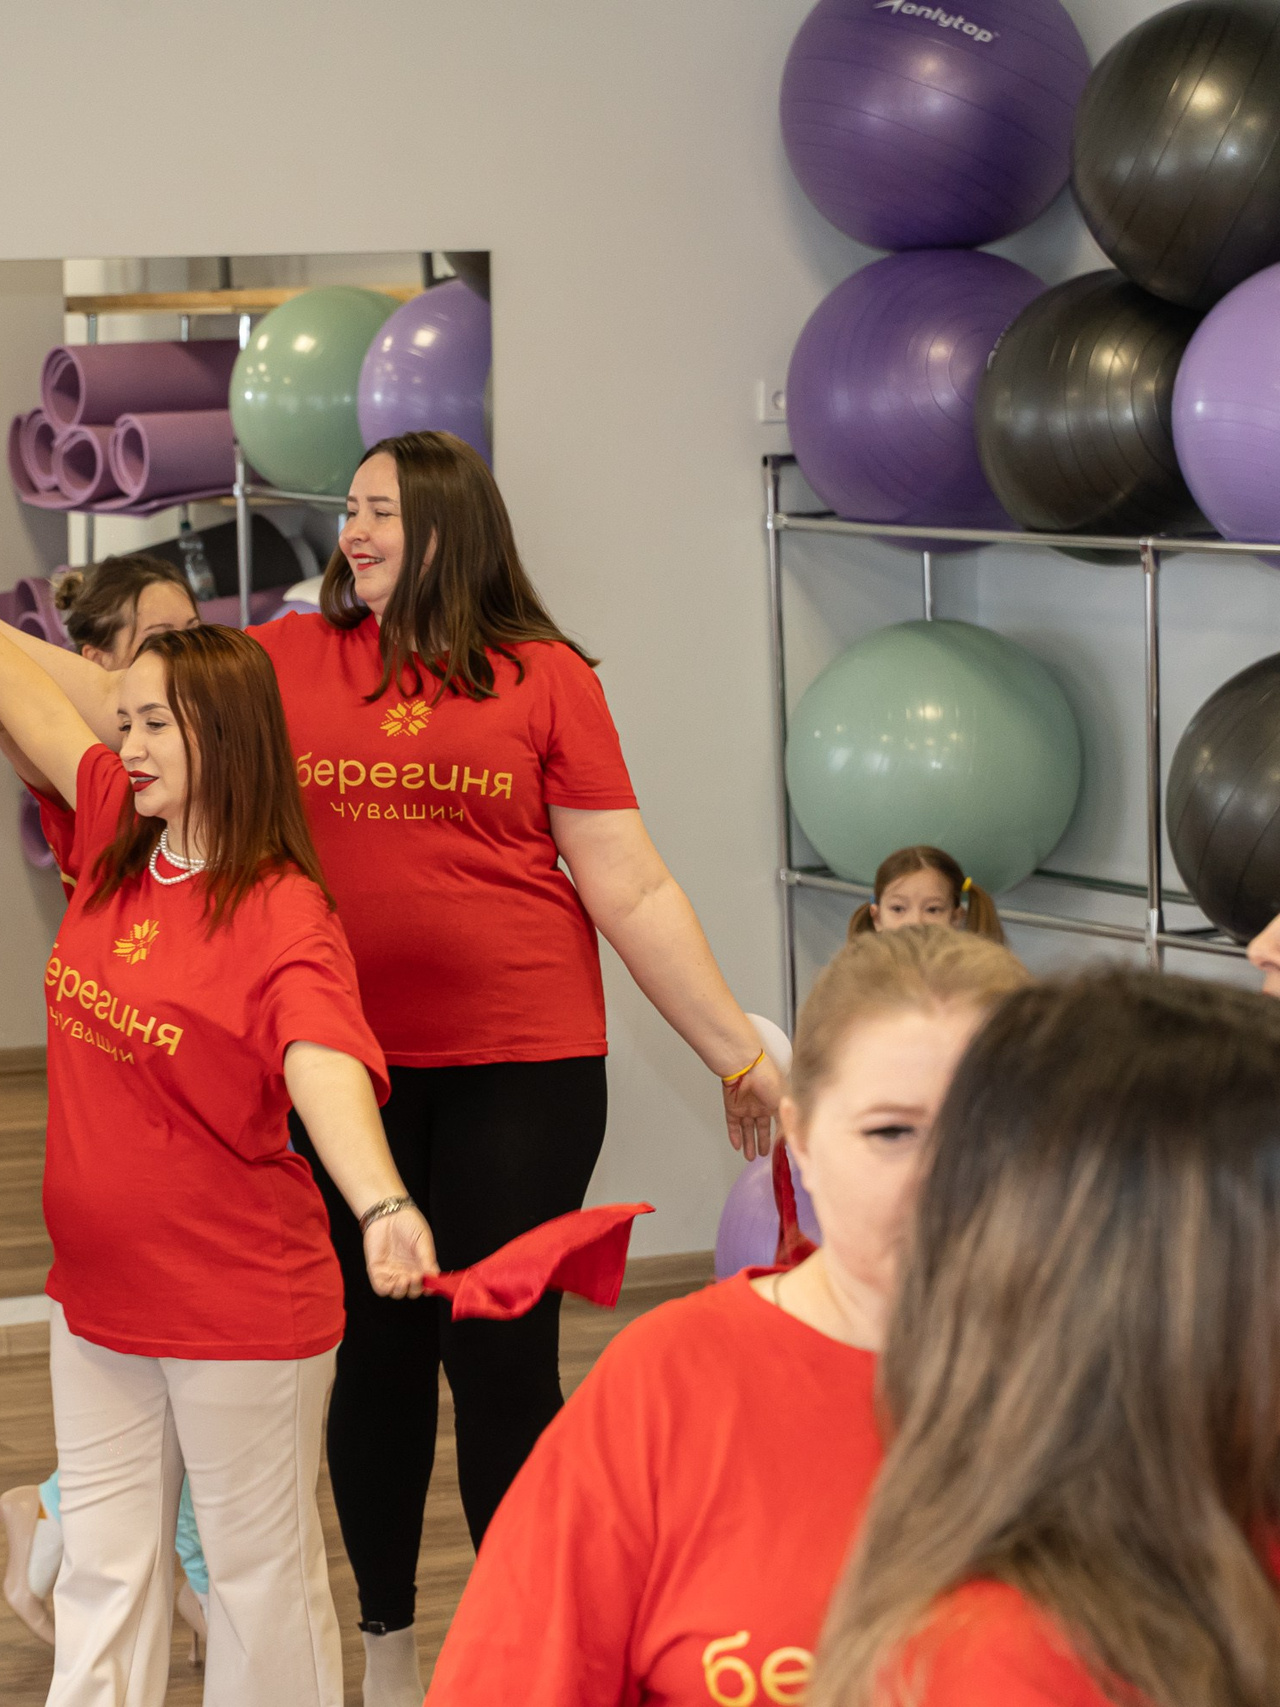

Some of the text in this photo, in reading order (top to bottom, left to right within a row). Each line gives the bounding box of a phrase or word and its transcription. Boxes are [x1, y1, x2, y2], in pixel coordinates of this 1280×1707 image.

[900, 2, 993, 43] onlytop
[296, 752, 513, 799] берегиня
[45, 943, 184, 1056] ерегиня
